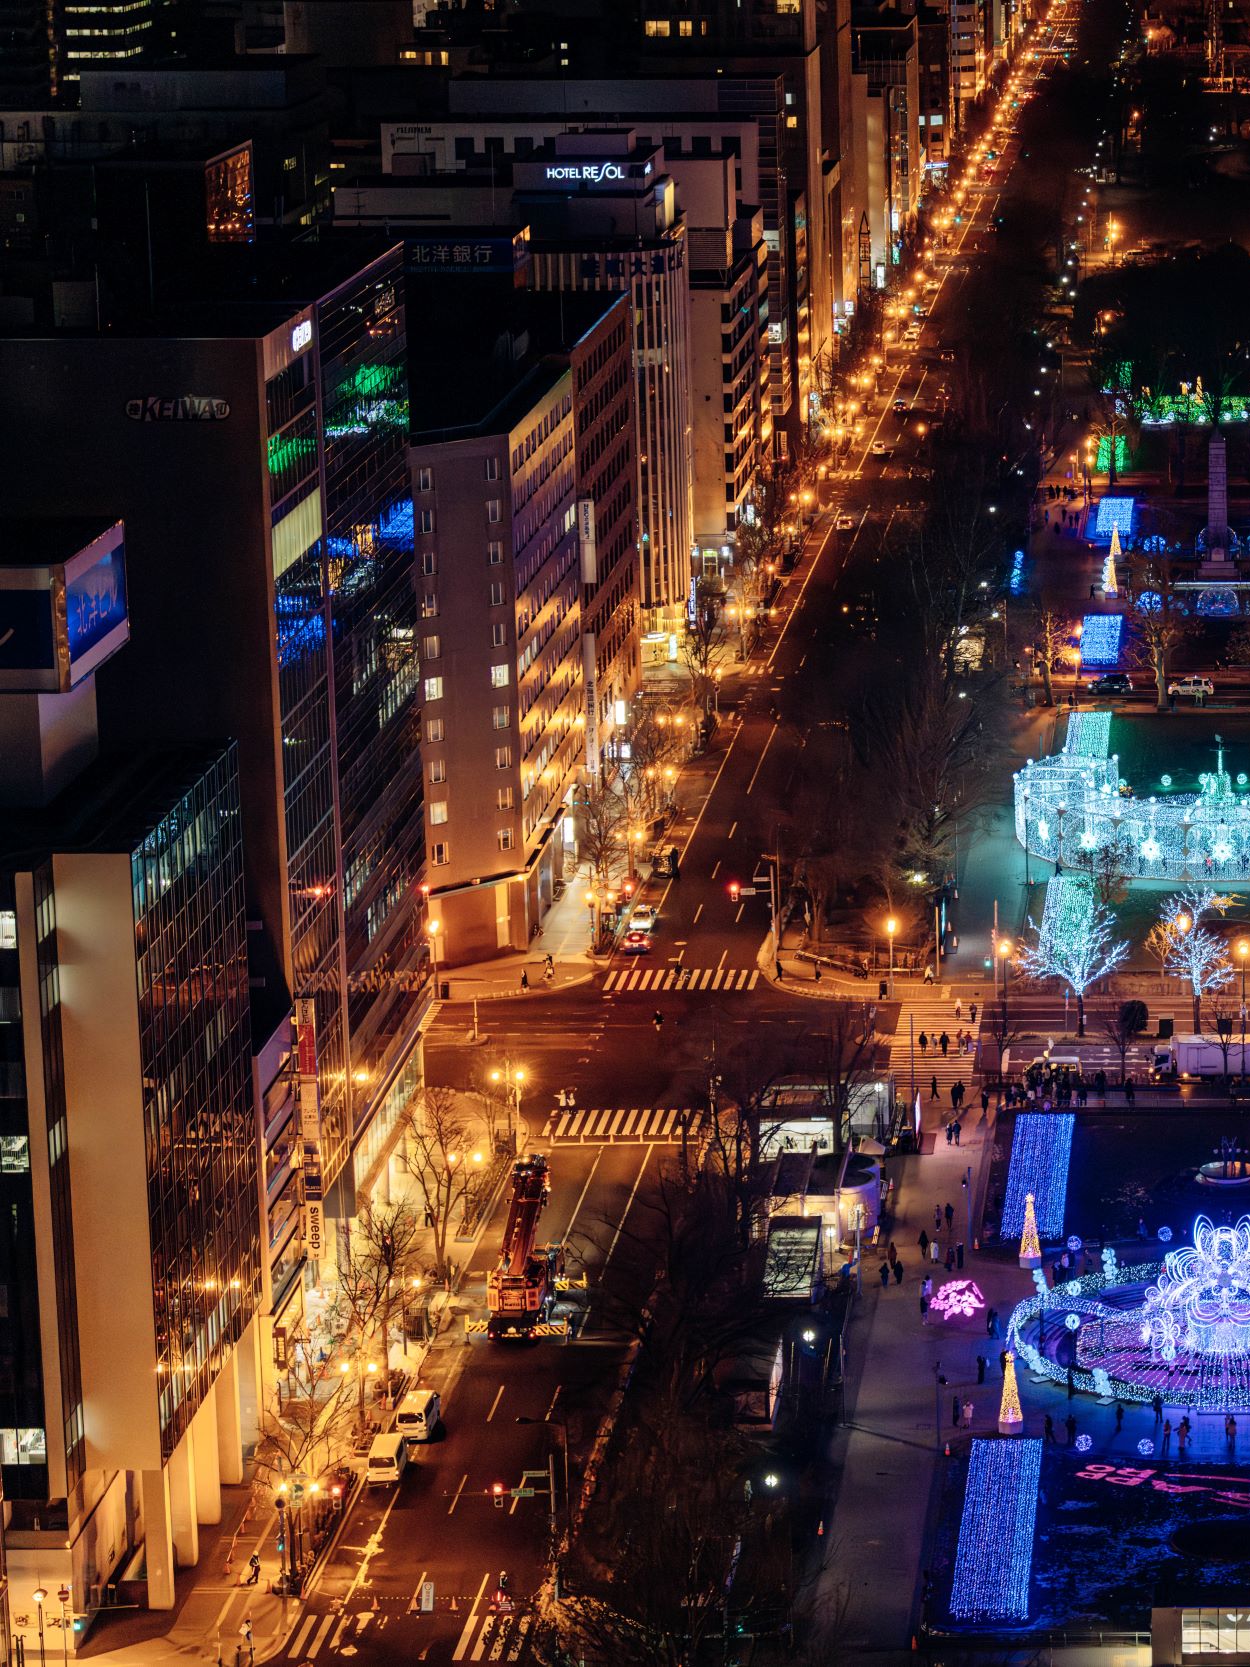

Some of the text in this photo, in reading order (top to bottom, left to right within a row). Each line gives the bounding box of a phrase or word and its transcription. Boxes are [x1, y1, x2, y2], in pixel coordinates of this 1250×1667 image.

[546, 162, 625, 182] HOTEL RESOL
[412, 244, 494, 264] 北洋銀行
[309, 1205, 321, 1250] sweep
